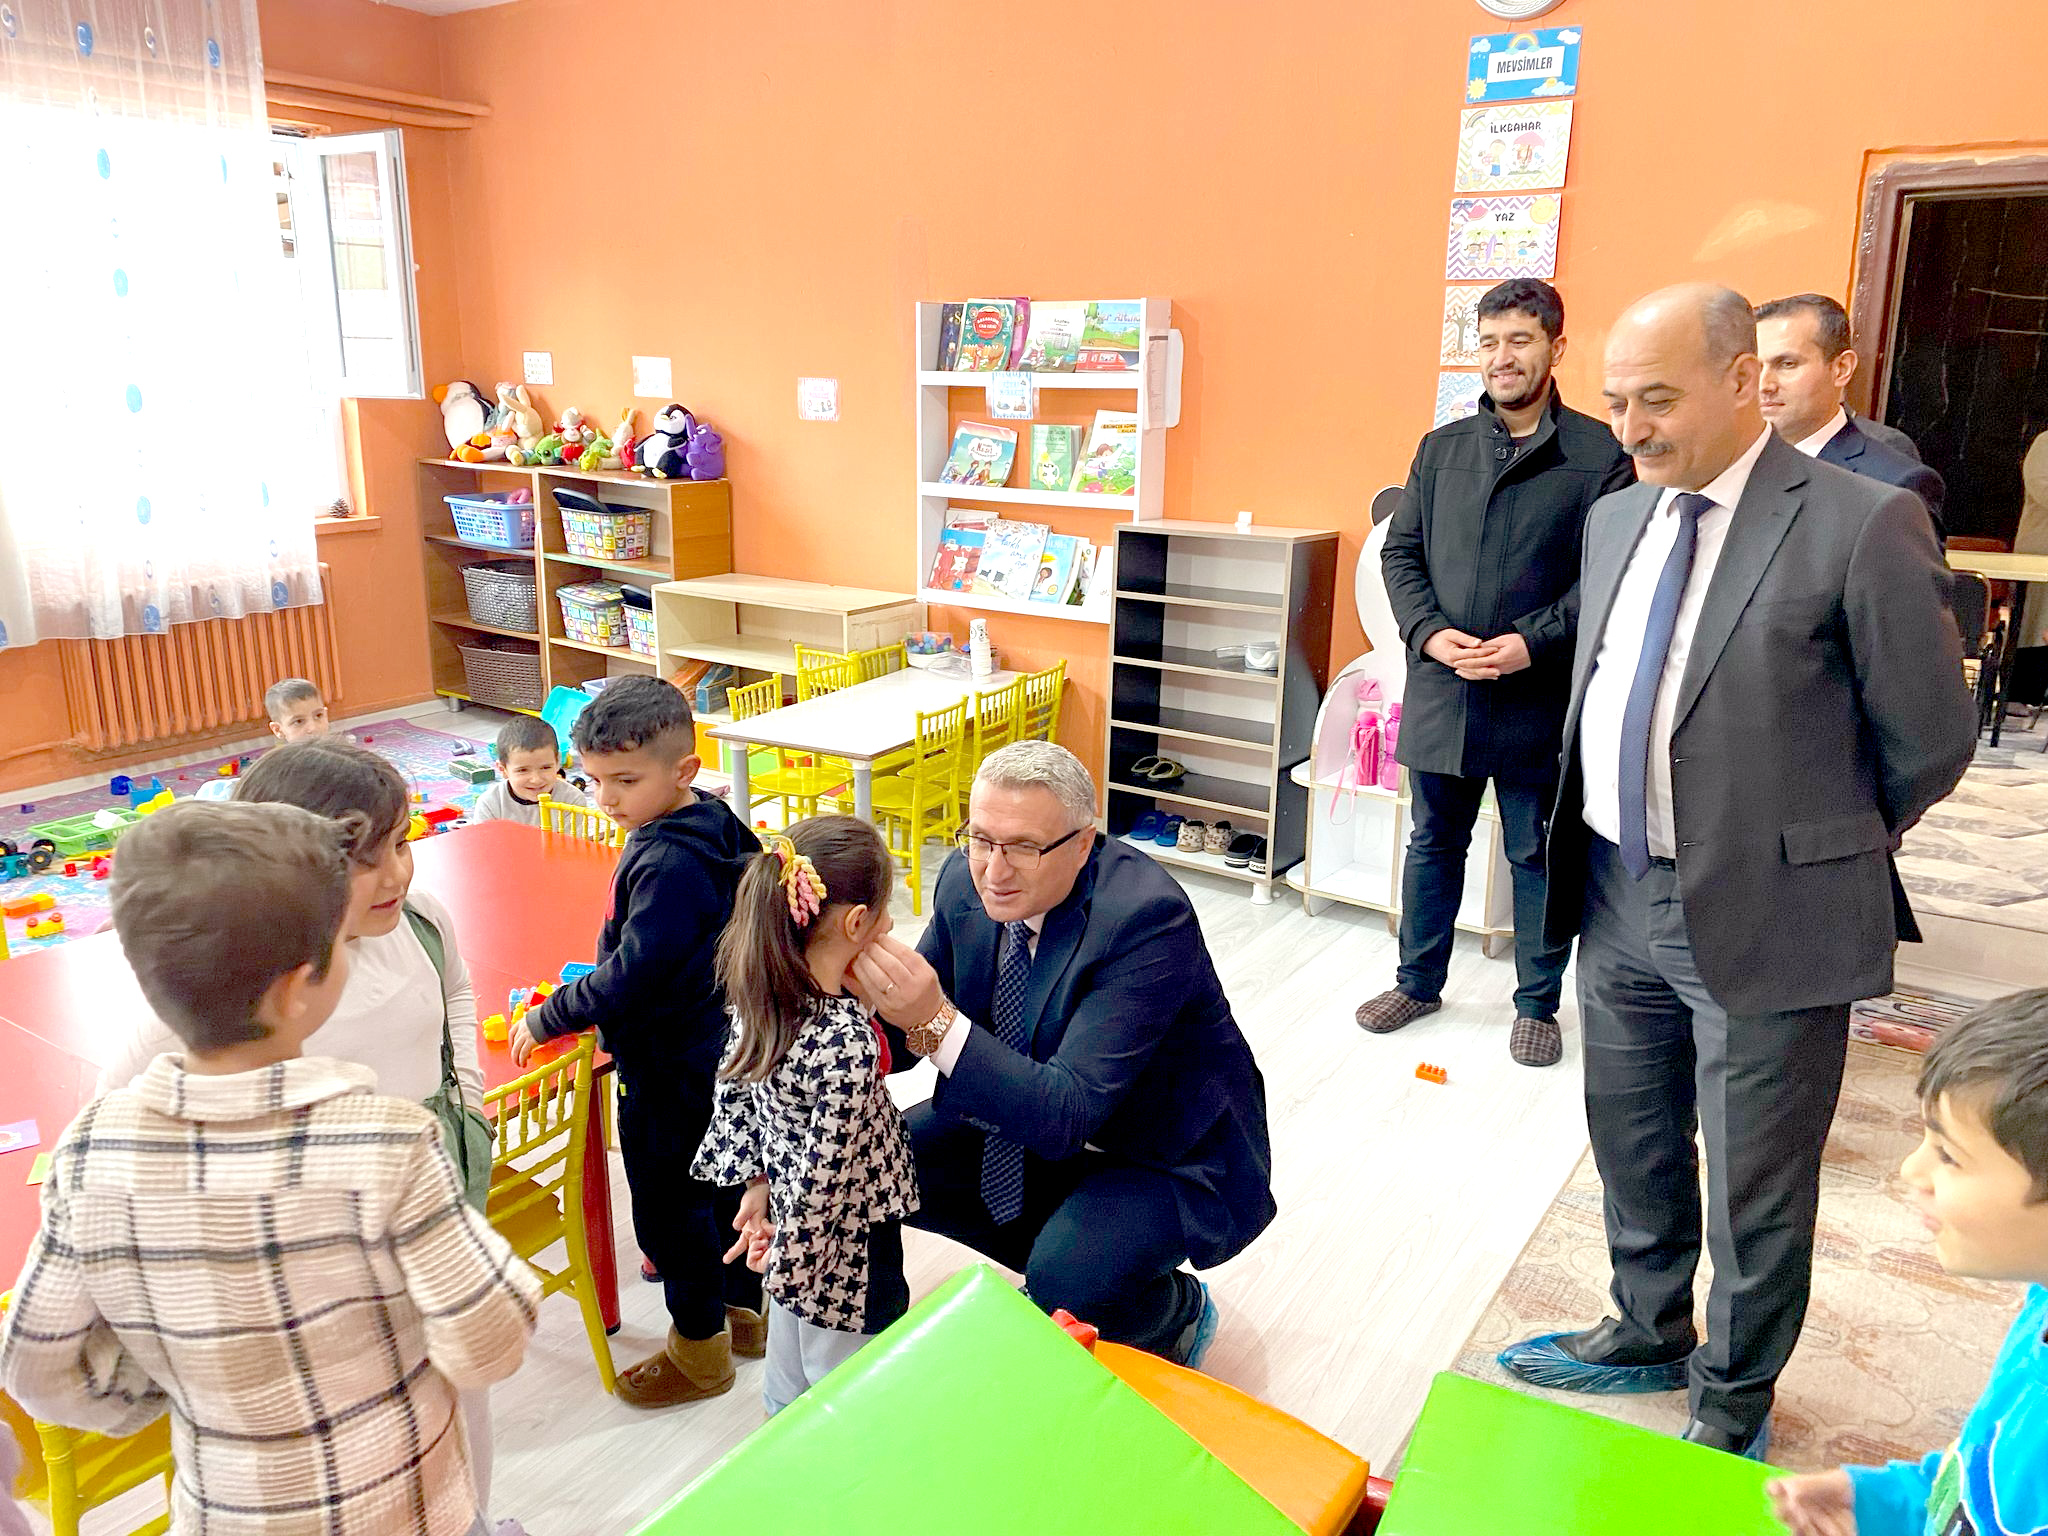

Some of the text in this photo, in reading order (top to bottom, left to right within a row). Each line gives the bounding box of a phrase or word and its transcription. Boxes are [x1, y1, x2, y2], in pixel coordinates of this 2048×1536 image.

[1496, 56, 1553, 74] MEVSİMLER
[1490, 121, 1542, 134] İLKBAHAR
[1494, 212, 1515, 222] YAZ
[570, 520, 601, 535] FUN BOX
